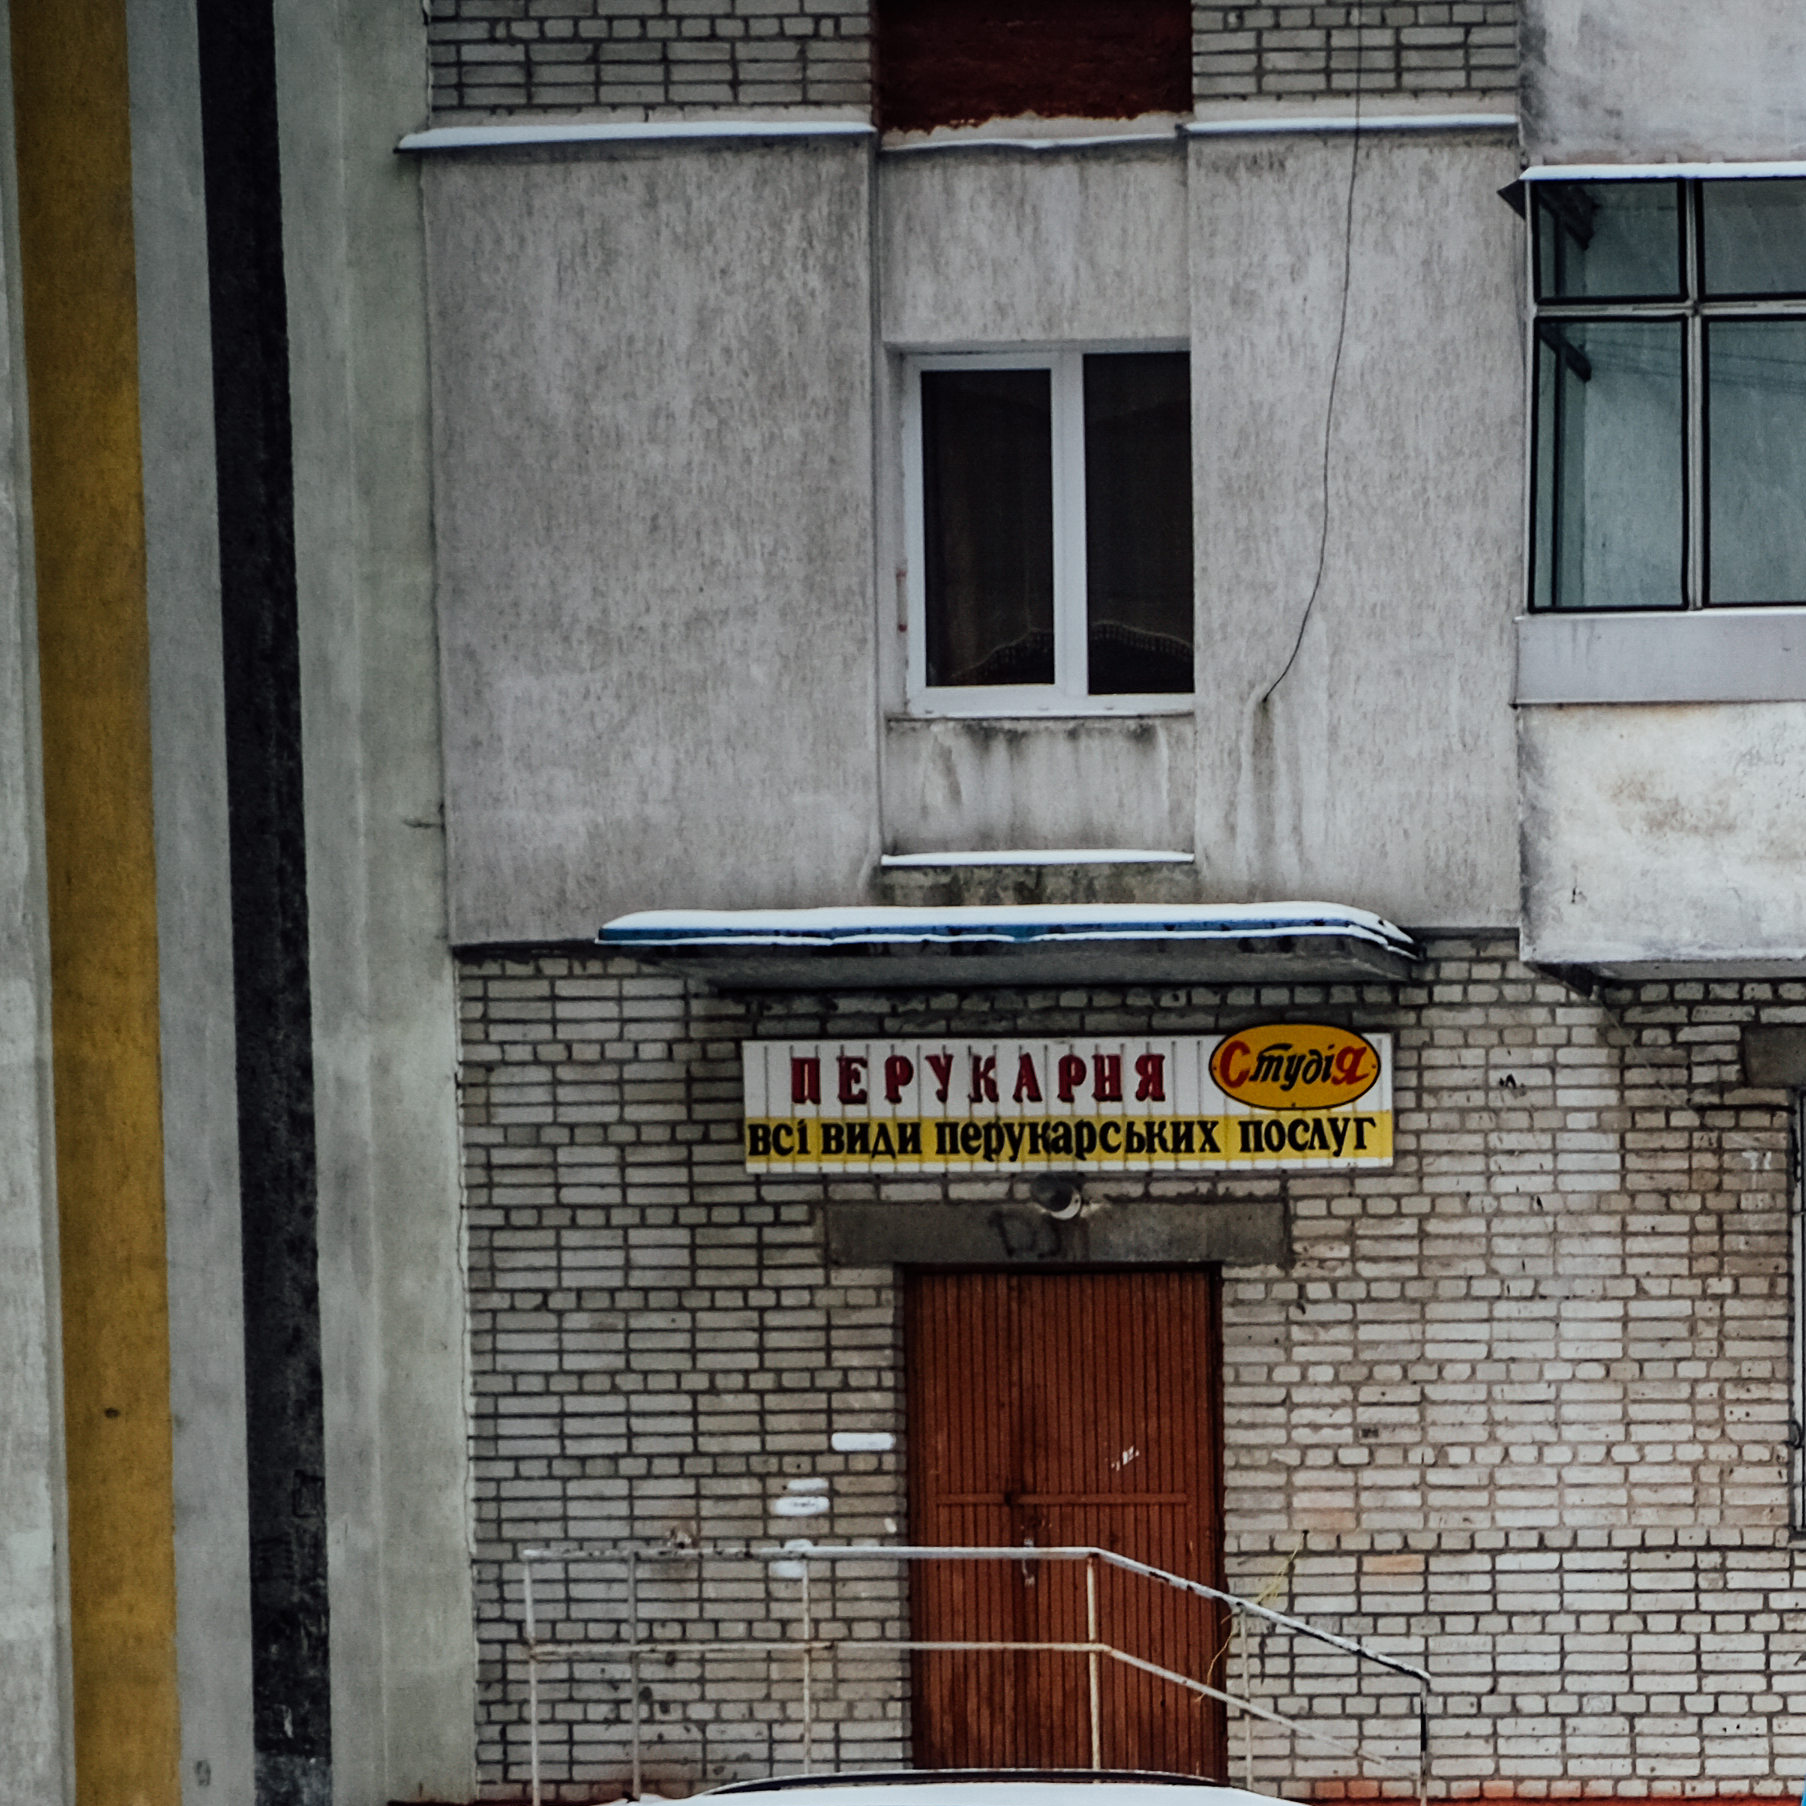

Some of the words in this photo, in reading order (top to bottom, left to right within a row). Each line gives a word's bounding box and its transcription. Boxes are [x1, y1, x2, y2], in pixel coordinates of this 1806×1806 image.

[790, 1052, 1167, 1105] ПЕРУКАРНЯ
[1219, 1040, 1370, 1092] Студія
[748, 1119, 811, 1157] всі
[820, 1119, 923, 1160] види
[934, 1116, 1222, 1160] перукарських
[1238, 1116, 1378, 1158] послуг
